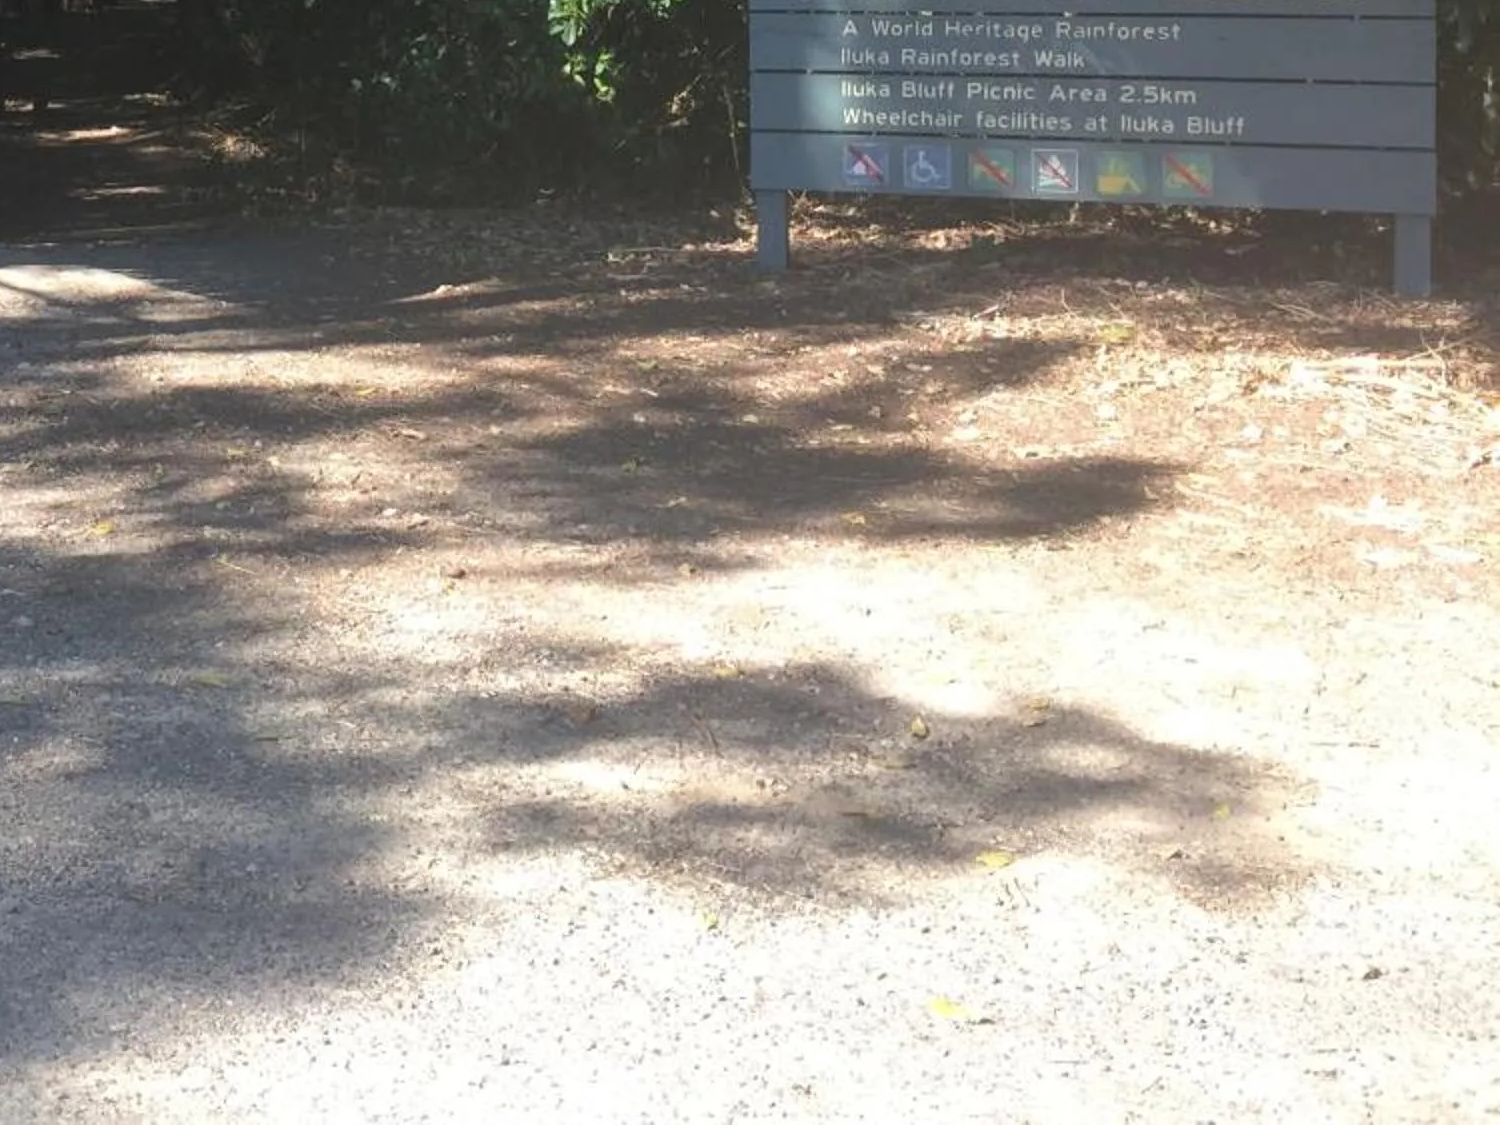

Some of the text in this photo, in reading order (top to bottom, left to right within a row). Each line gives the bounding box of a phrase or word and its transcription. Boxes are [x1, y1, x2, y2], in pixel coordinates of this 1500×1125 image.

[842, 19, 1181, 43] A World Heritage Rainforest
[841, 48, 1085, 68] Iluka Rainforest Walk
[841, 81, 1196, 105] Iluka Bluff Picnic Area 2.5km
[843, 108, 1244, 136] Wheelchair facilities at Iluka Bluff
